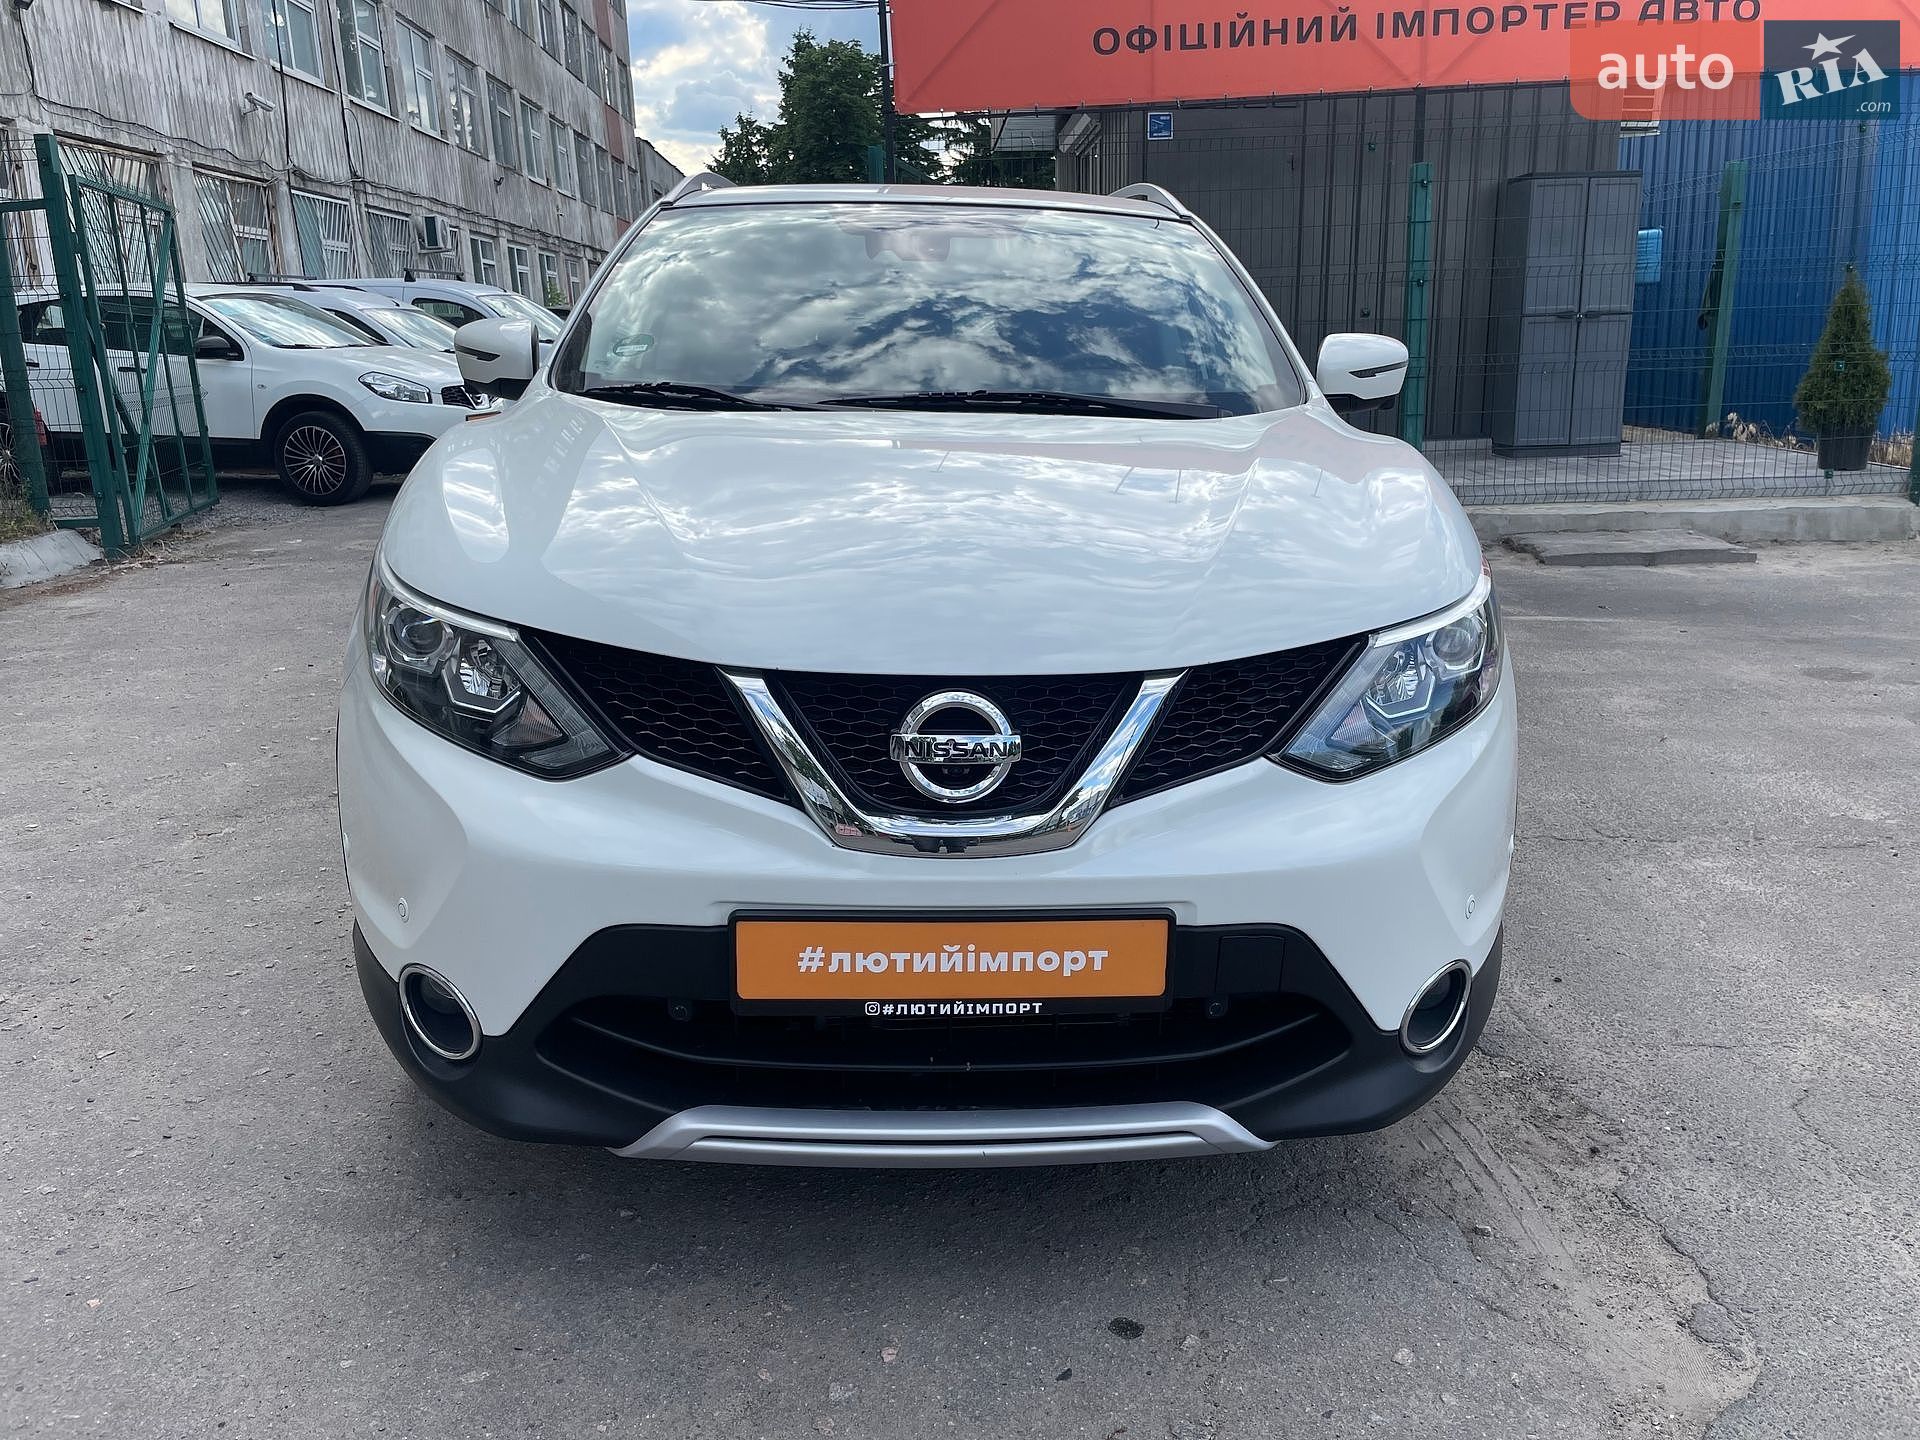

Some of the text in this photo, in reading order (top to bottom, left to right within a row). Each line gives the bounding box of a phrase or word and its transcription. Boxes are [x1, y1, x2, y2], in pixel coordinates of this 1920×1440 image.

[1092, 0, 1762, 55] ОФІЦІЙНИЙ ІМПОРТЕР АВТО
[903, 739, 1009, 758] NISSAN
[797, 943, 1109, 976] #лютийімпорт
[882, 1000, 1043, 1016] #ЛЮТИЙІМПОРТ
